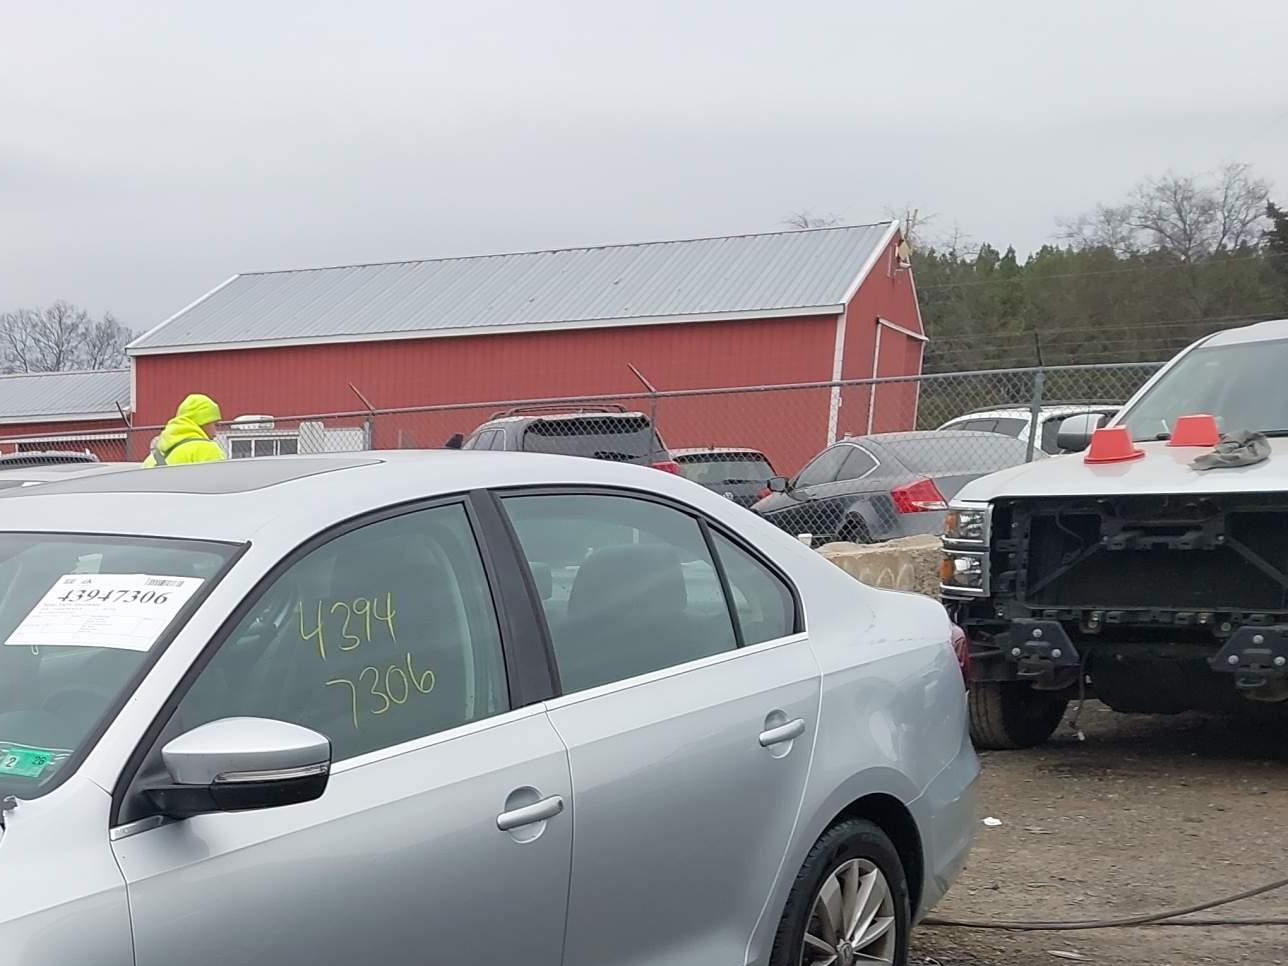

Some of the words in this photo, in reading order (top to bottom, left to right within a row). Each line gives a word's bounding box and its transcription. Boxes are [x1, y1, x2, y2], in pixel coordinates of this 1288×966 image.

[57, 589, 173, 605] 43947306
[297, 592, 397, 662] 4394
[325, 652, 436, 729] 7306
[6, 757, 17, 768] 2
